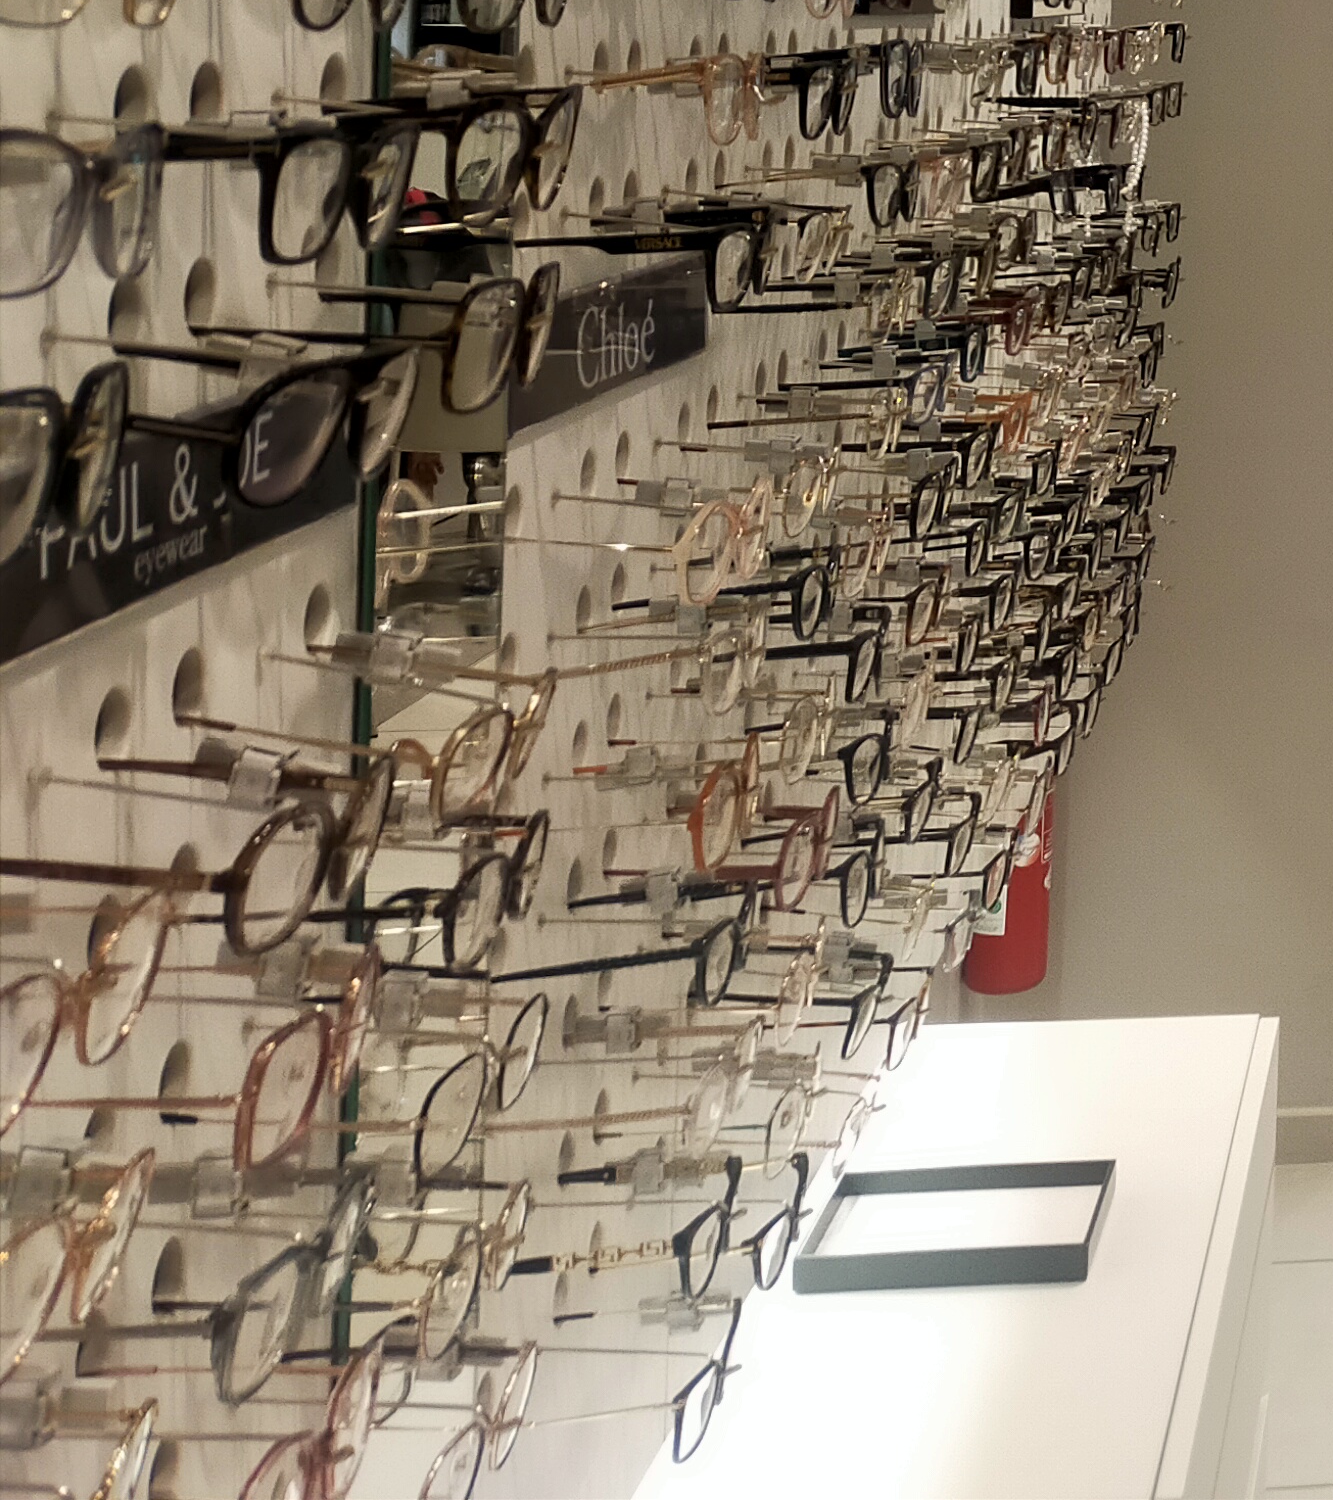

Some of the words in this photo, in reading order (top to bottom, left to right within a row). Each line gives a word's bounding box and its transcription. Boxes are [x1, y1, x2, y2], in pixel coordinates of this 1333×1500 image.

[577, 298, 656, 389] Chloé
[169, 442, 199, 526] &
[133, 524, 209, 585] eyewear
